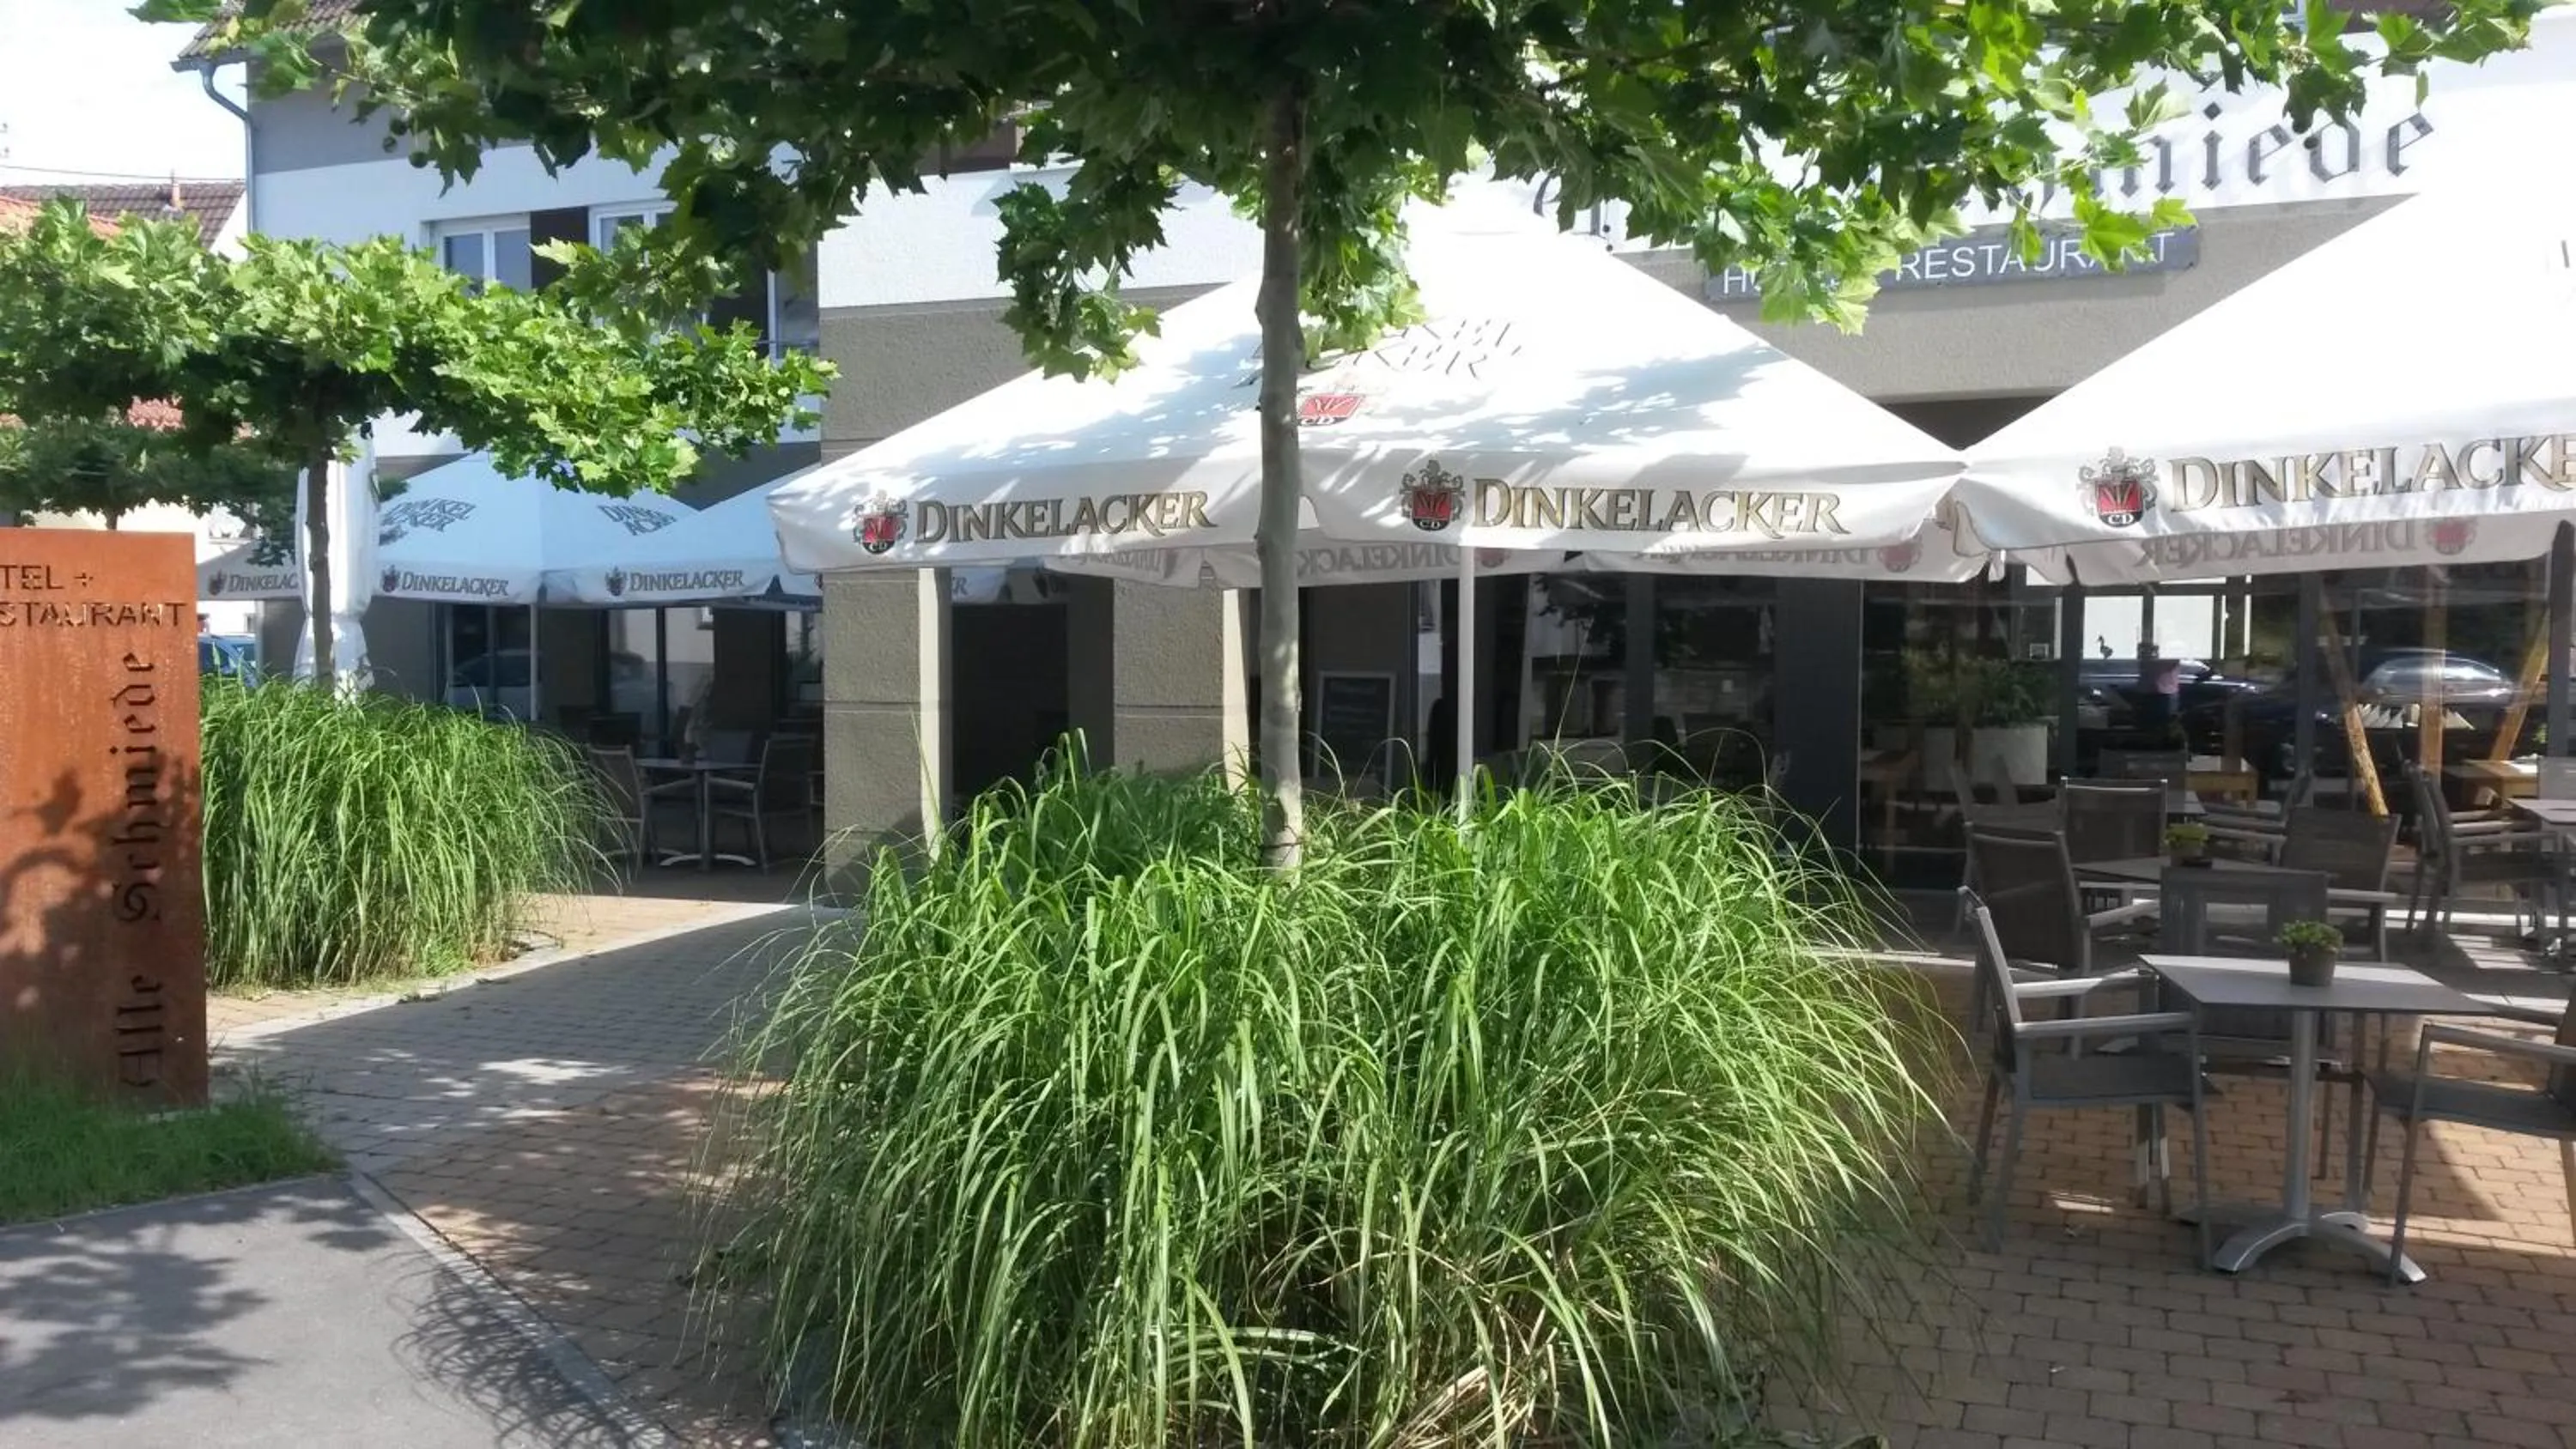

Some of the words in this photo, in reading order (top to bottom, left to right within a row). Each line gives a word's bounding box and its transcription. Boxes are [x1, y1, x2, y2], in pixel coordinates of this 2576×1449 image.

[914, 490, 1217, 544] DINKELACKER
[1473, 477, 1851, 540] DINKELACKER
[0, 564, 64, 590] TEL
[402, 571, 509, 597] DINKELACKER
[629, 570, 744, 592] DINKELACKER
